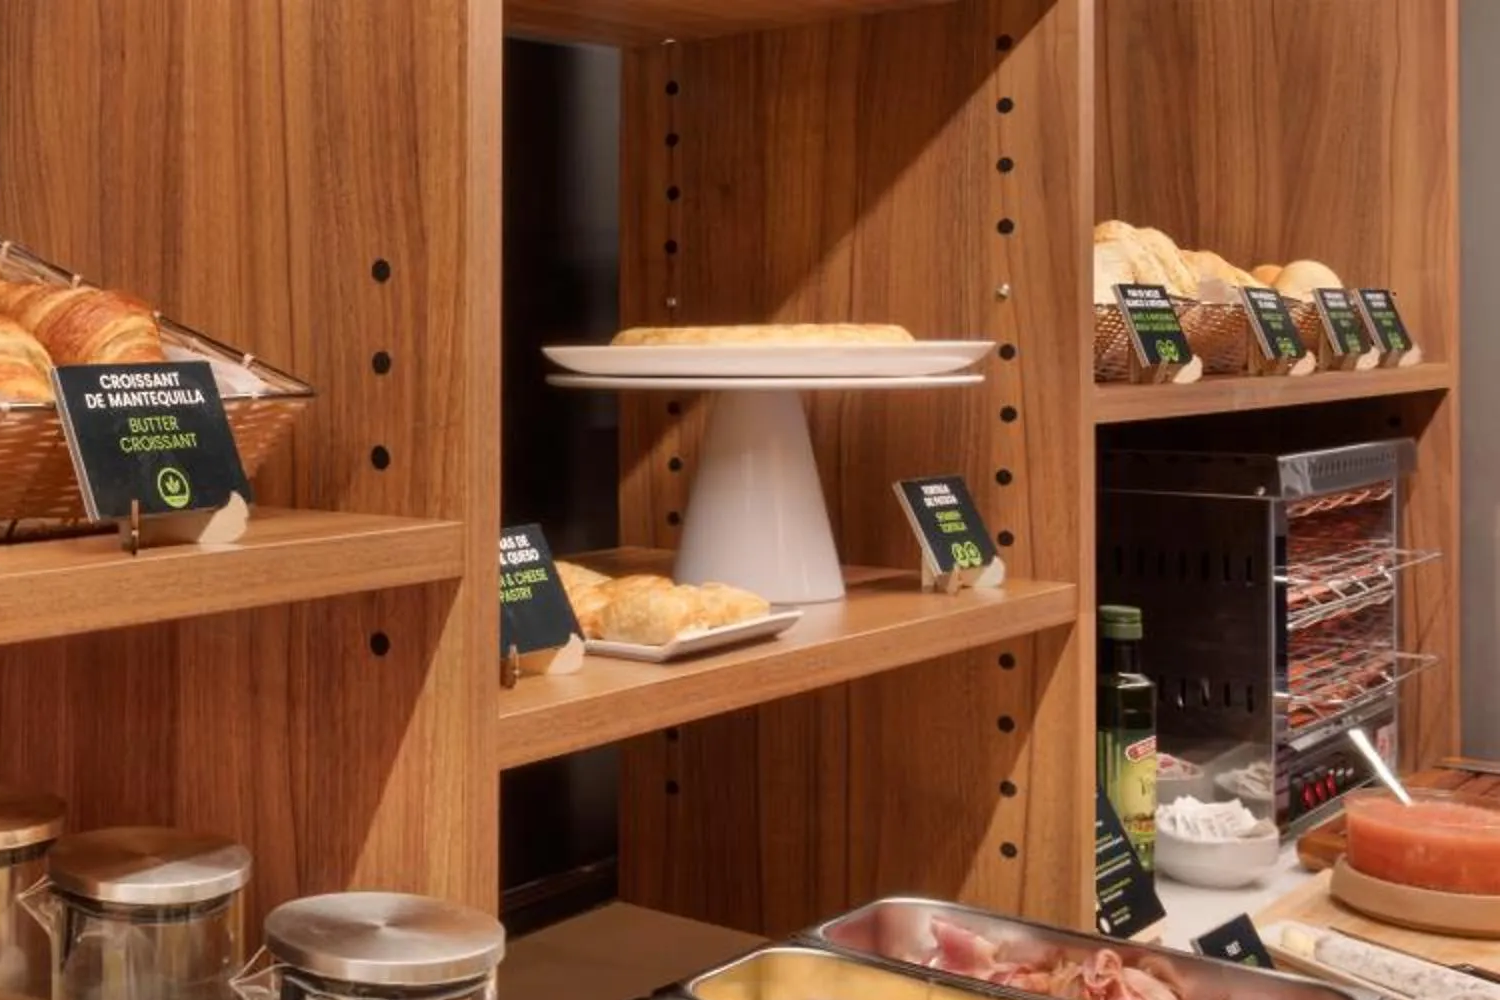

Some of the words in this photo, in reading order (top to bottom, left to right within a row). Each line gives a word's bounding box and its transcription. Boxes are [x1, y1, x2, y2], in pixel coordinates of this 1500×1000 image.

[99, 371, 180, 390] CROISSANT
[85, 392, 106, 409] DE
[107, 388, 206, 408] MANTEQUILLA
[128, 415, 179, 433] BUTTER
[119, 432, 198, 453] CROISSANT
